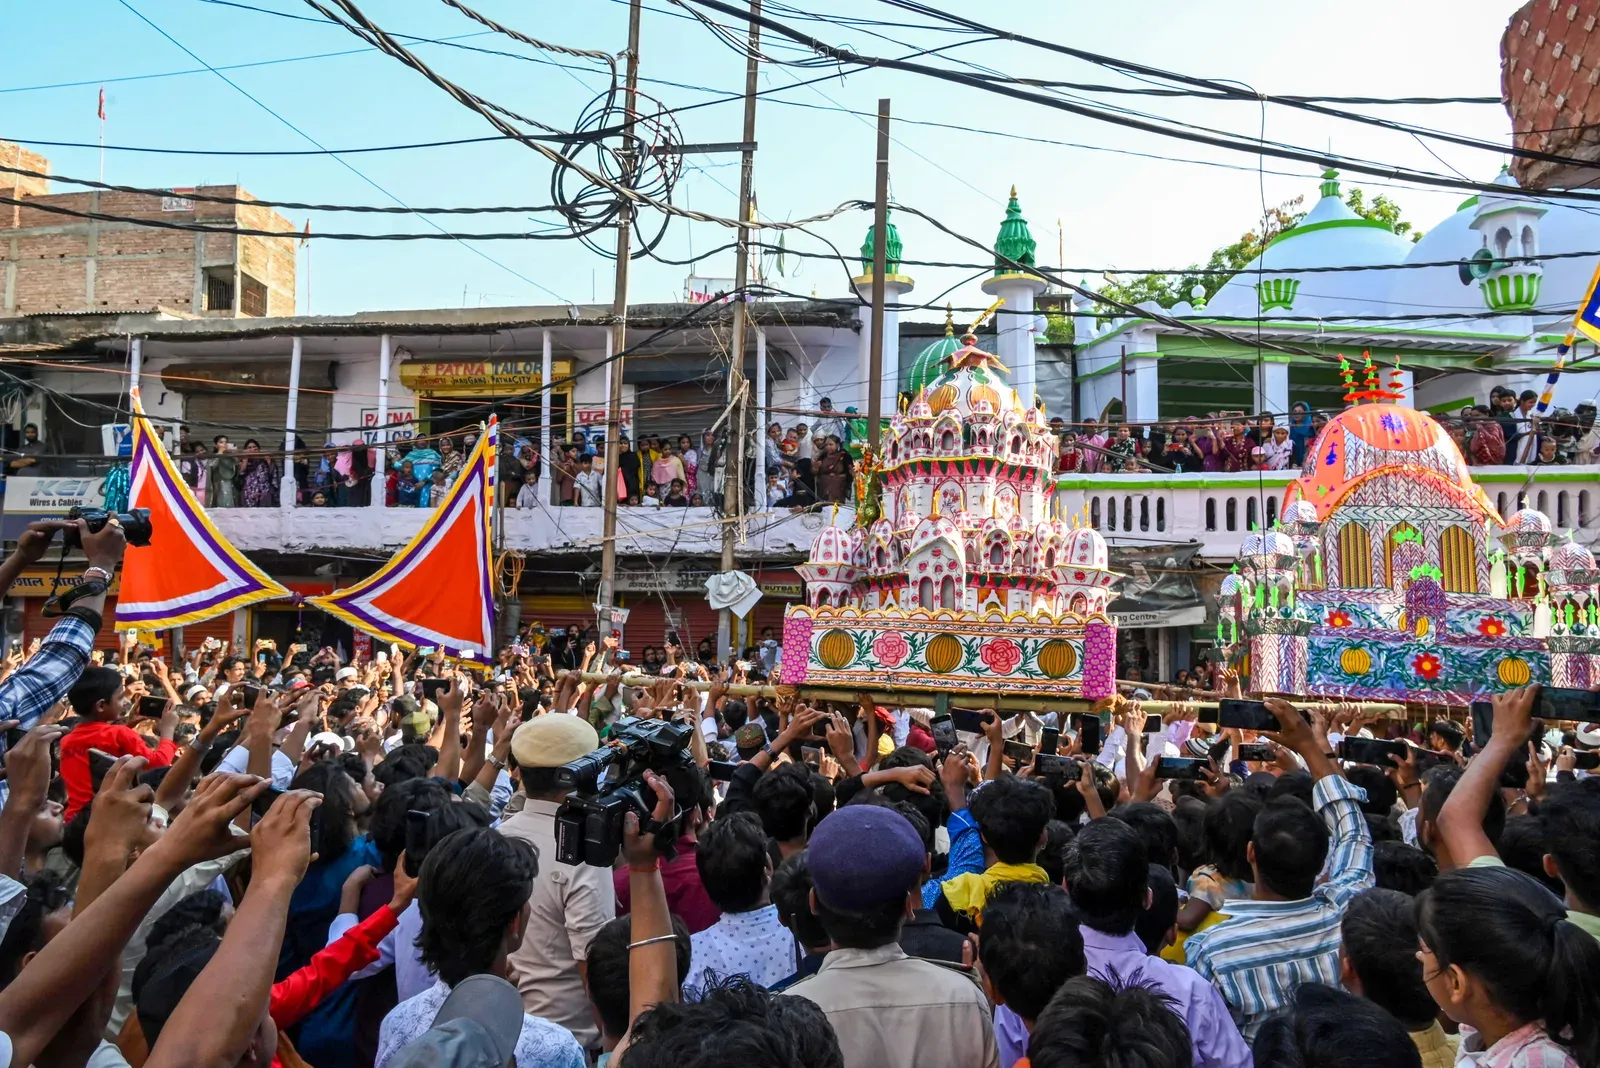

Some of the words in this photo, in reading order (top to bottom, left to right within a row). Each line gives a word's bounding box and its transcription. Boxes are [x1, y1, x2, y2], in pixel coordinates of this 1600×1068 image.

[435, 362, 486, 376] PATNA
[494, 361, 543, 375] TAILOR
[364, 430, 412, 446] TALOR
[30, 480, 91, 496] KEI
[30, 498, 49, 507] Wires
[51, 499, 56, 507] &
[58, 498, 82, 507] Cables
[1129, 613, 1157, 621] Centre
